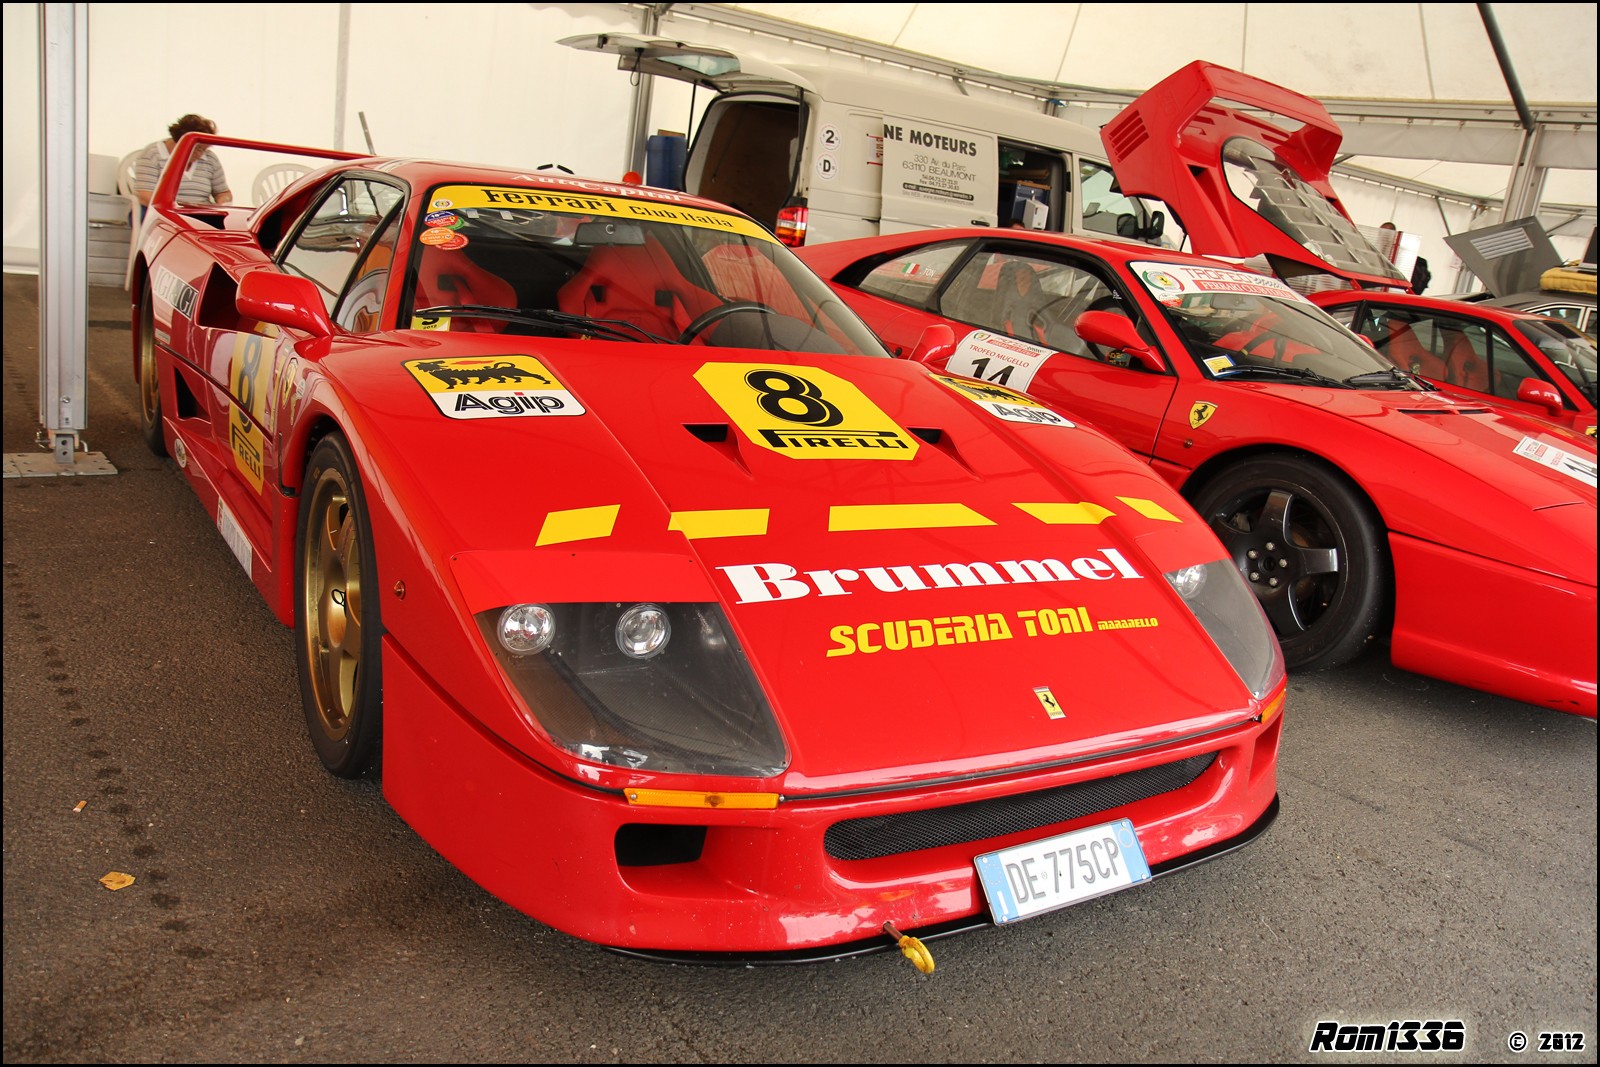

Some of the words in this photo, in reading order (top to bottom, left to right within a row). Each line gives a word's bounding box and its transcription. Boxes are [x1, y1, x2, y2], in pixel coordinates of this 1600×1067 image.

[825, 129, 835, 144] 2
[909, 130, 977, 157] MOTEURS
[823, 159, 831, 173] D
[902, 160, 926, 173] 63110
[929, 166, 976, 182] BEAUMONT
[914, 154, 929, 165] 330
[942, 160, 951, 168] du
[952, 162, 967, 172] Parc
[482, 189, 619, 213] Ferrari
[628, 205, 678, 219] Club
[680, 212, 734, 228] Italia
[1180, 267, 1253, 284] TROFEO
[1200, 280, 1243, 292] FERRARI
[969, 344, 996, 357] TROFEO
[996, 353, 1030, 368] MUGELLO
[238, 333, 263, 434] 8
[971, 357, 1015, 386] 14
[454, 391, 565, 415] Agip
[744, 369, 844, 428] 8
[992, 403, 1061, 424] Agip
[758, 429, 909, 449] PIRELLI
[714, 548, 1144, 604] Brummel
[826, 612, 1013, 657] SCUDERIA
[1017, 606, 1093, 637] TONI
[1097, 618, 1158, 631] MARANELLO
[1005, 857, 1046, 905] DE
[1043, 837, 1119, 894] 775CP
